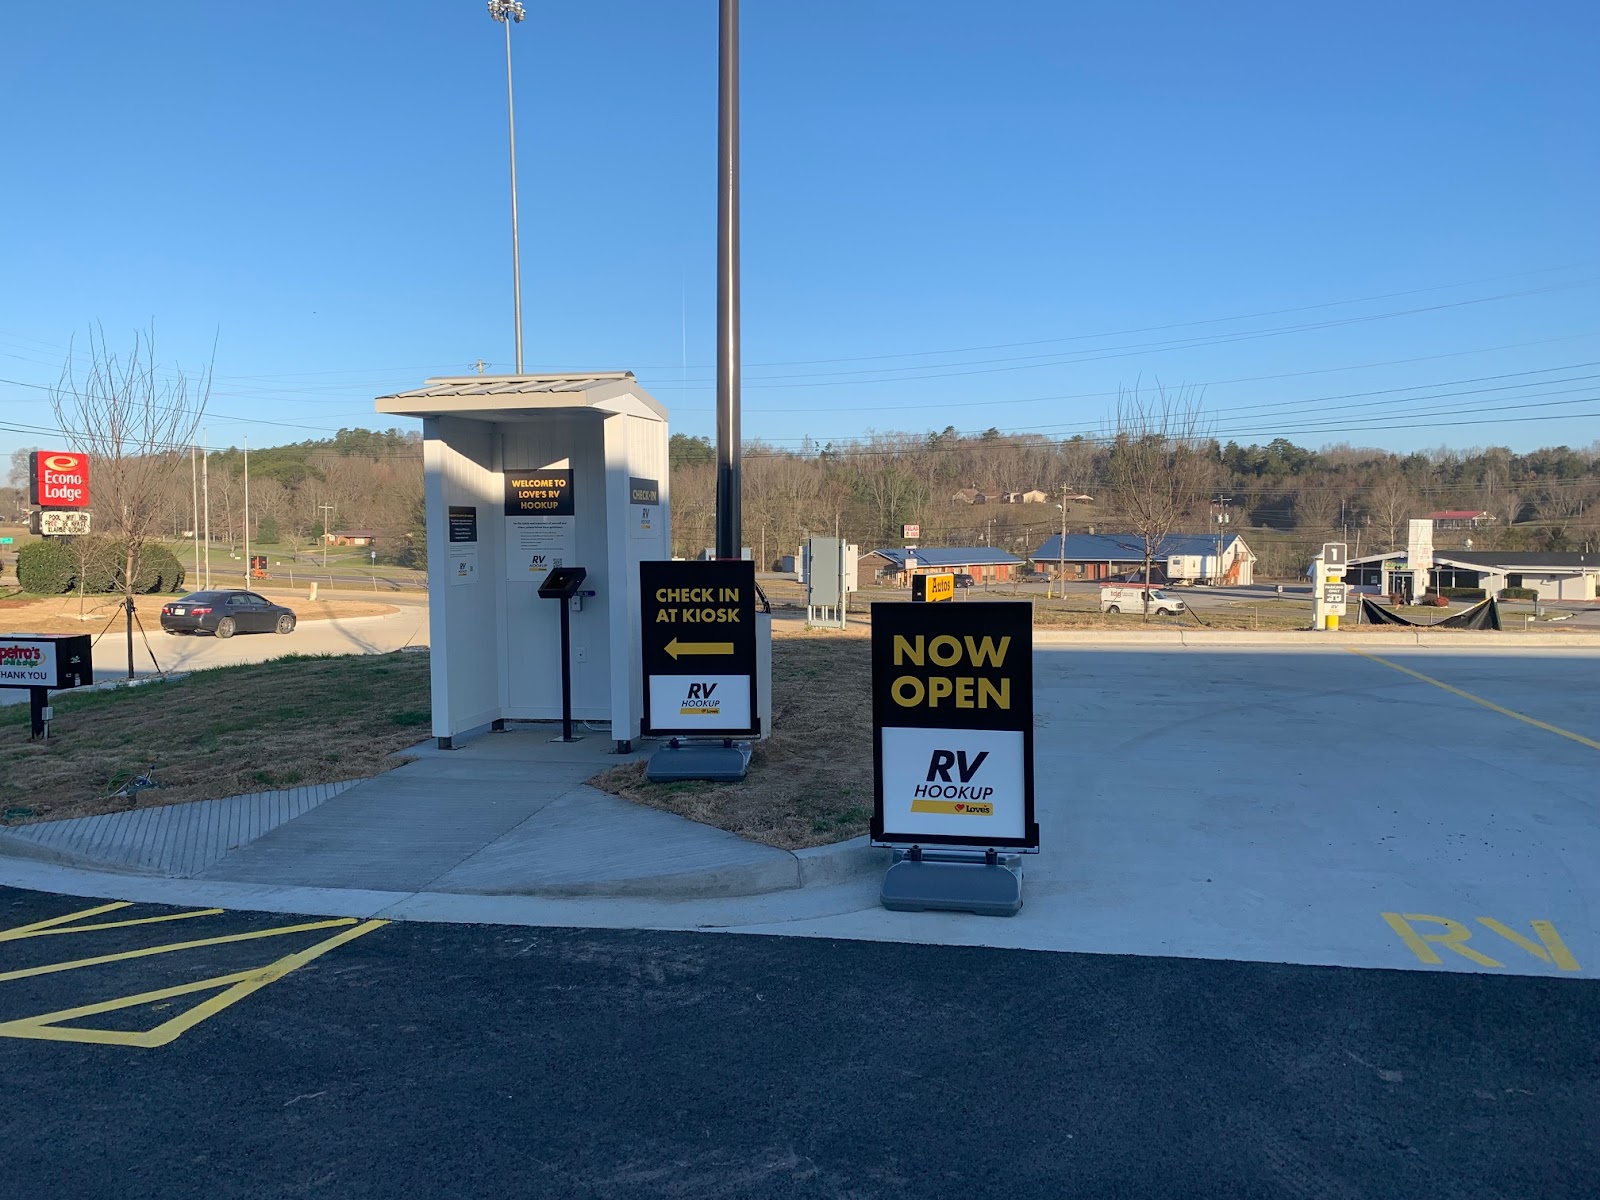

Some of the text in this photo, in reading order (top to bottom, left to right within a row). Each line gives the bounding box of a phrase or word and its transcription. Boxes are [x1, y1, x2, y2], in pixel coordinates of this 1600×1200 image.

[44, 470, 82, 484] Econo
[512, 480, 566, 488] WELCOME TO
[45, 484, 82, 502] Lodge
[518, 490, 560, 498] LOVE'S RV
[632, 490, 656, 501] CHECK-IN
[532, 556, 546, 564] RV
[1332, 548, 1338, 560] 1
[932, 578, 950, 592] Autos
[656, 588, 739, 602] CHECK IN
[656, 608, 740, 622] AT KIOSK
[0, 645, 40, 665] petro's
[893, 634, 1012, 668] NOW
[0, 671, 46, 680] HANK YOU
[688, 682, 718, 699] RV
[891, 675, 1010, 710] OPEN
[926, 750, 990, 782] RV
[914, 784, 994, 800] HOOKUP
[966, 805, 990, 813] Love's
[1380, 912, 1582, 971] RV
